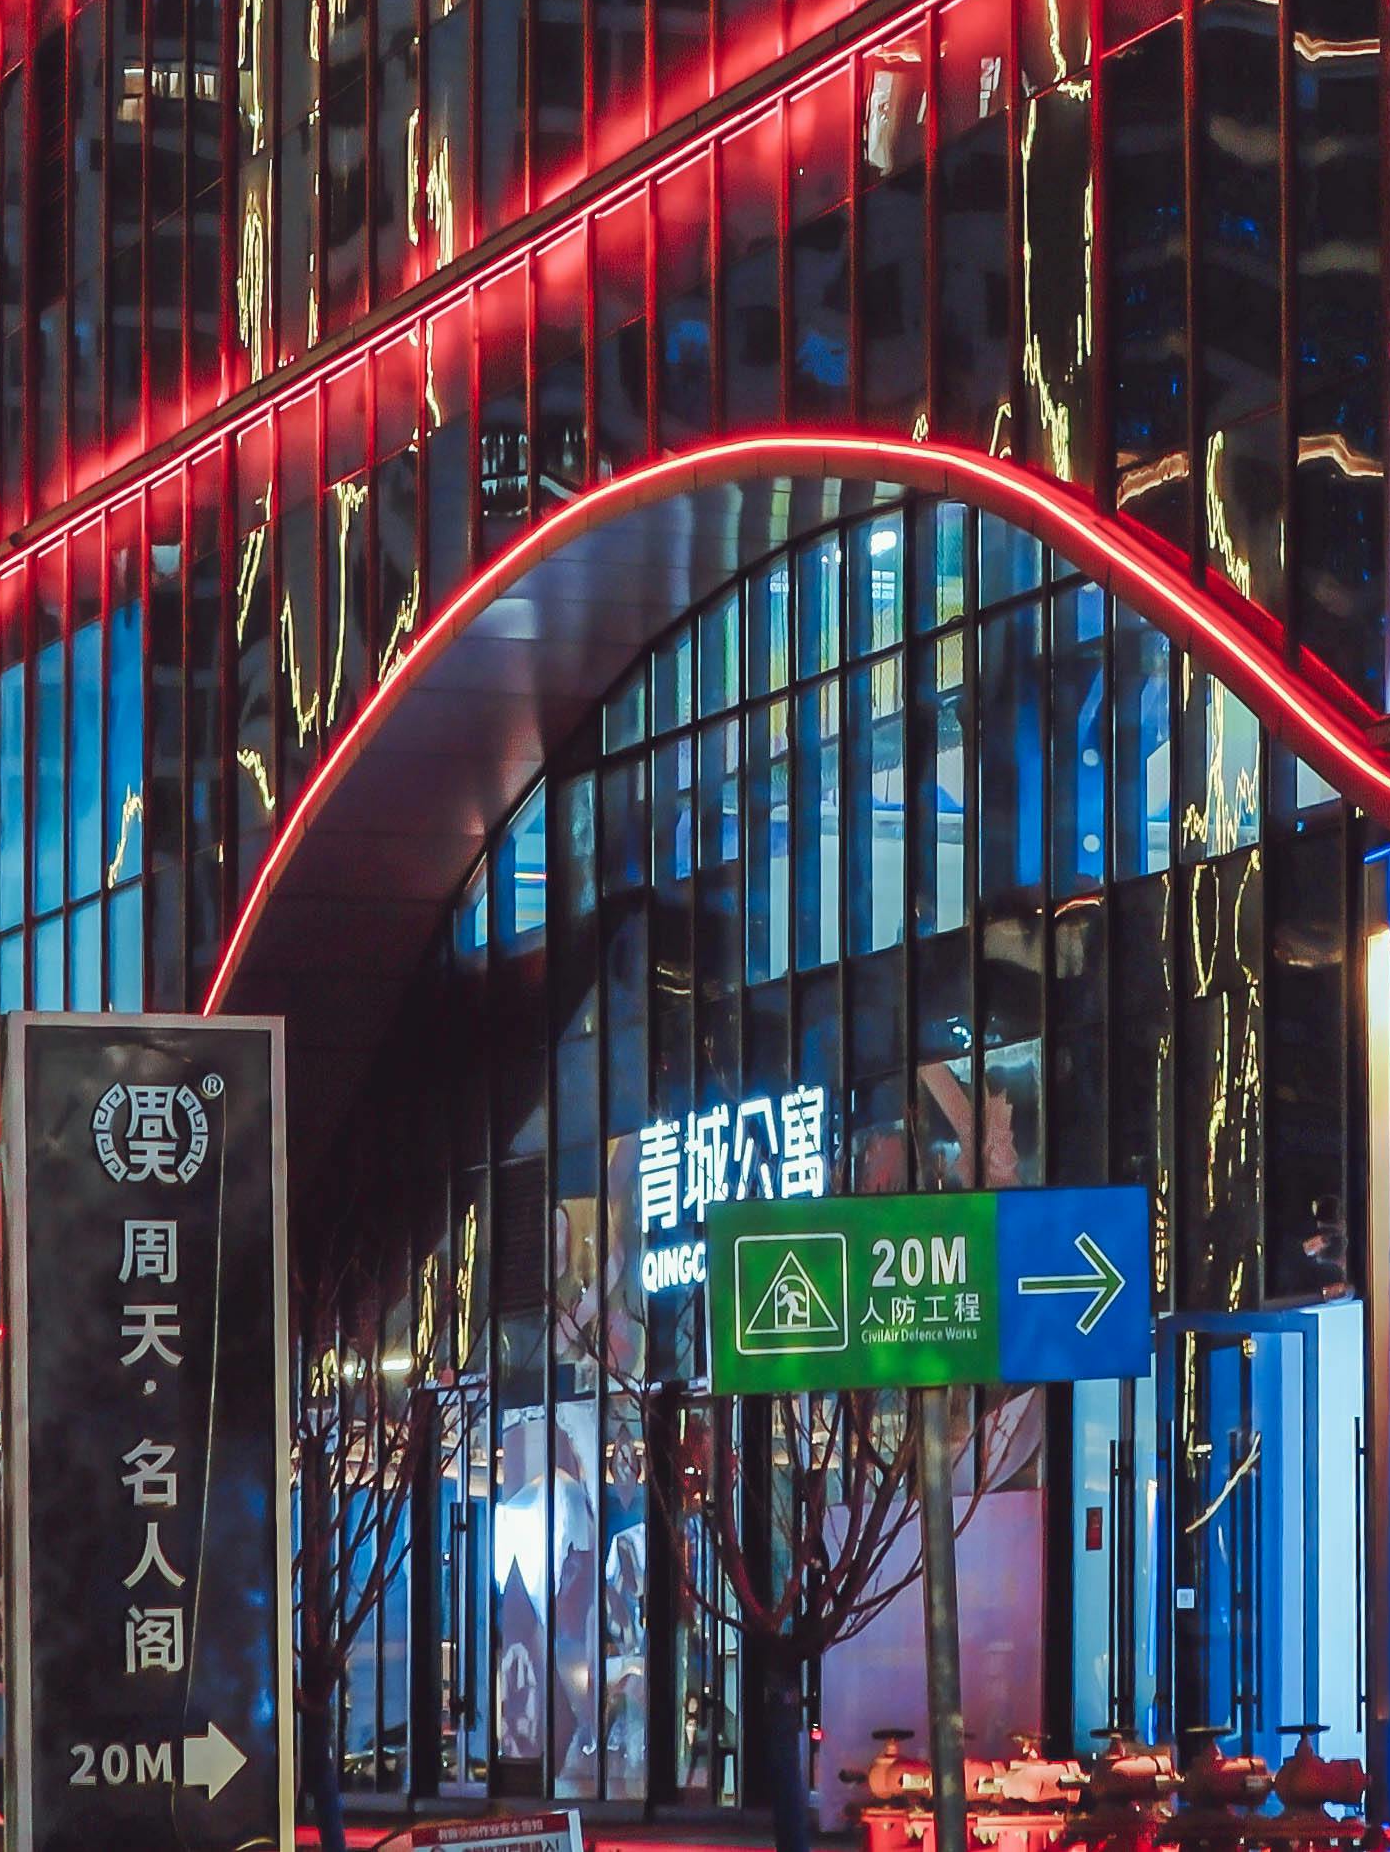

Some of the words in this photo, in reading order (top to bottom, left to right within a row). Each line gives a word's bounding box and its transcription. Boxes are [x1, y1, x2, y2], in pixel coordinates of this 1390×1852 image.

[639, 1084, 825, 1233] 青城公寓
[871, 1235, 967, 1288] 20M
[859, 1293, 981, 1326] 人防工程
[945, 1326, 978, 1341] Works
[69, 1742, 174, 1786] 20M
